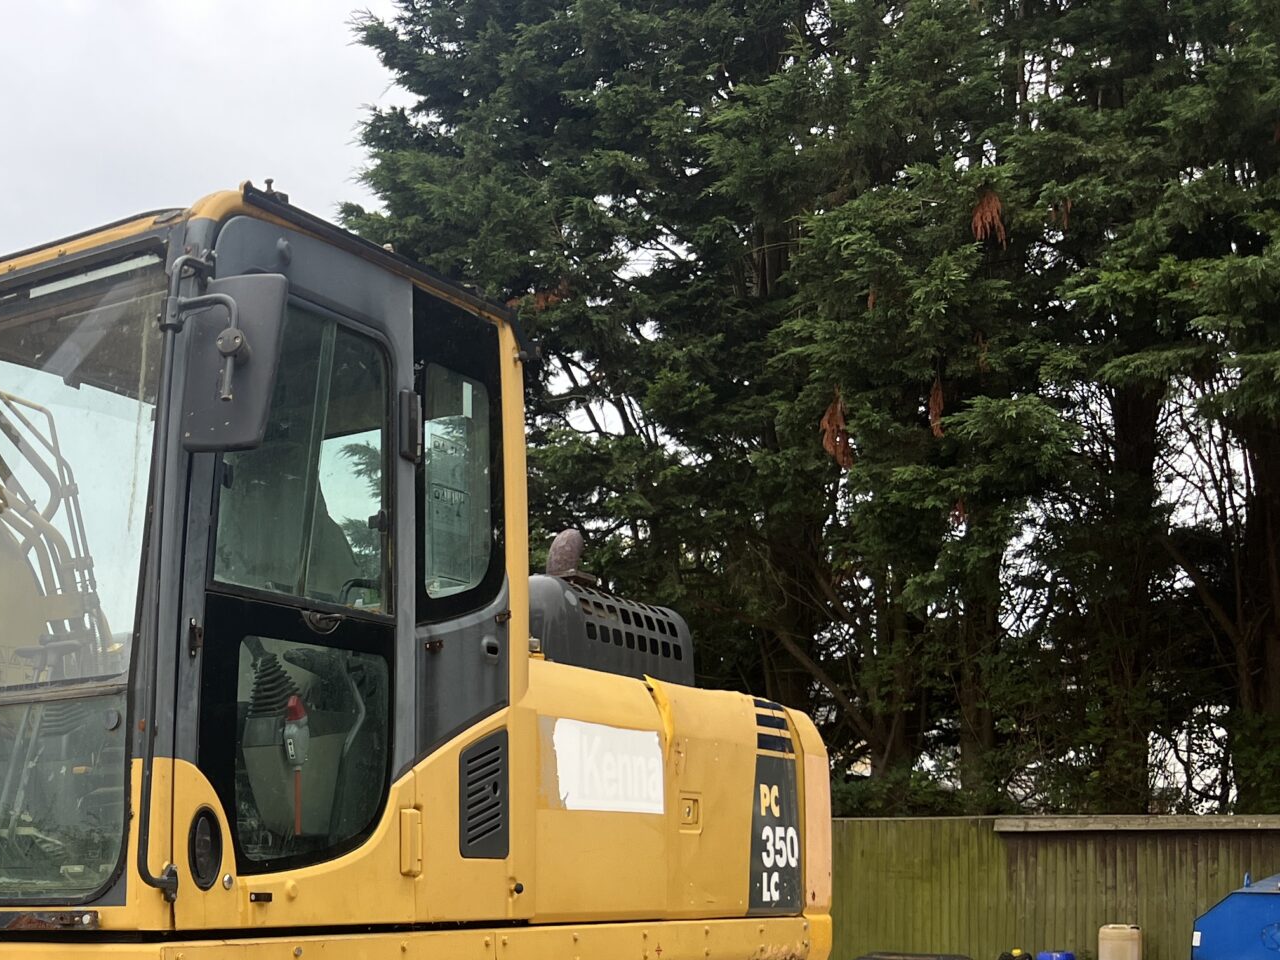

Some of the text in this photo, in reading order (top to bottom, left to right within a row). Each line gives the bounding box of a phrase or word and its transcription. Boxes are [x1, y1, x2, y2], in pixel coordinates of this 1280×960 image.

[759, 783, 780, 818] PC
[761, 826, 799, 868] 350
[762, 872, 780, 902] LC
